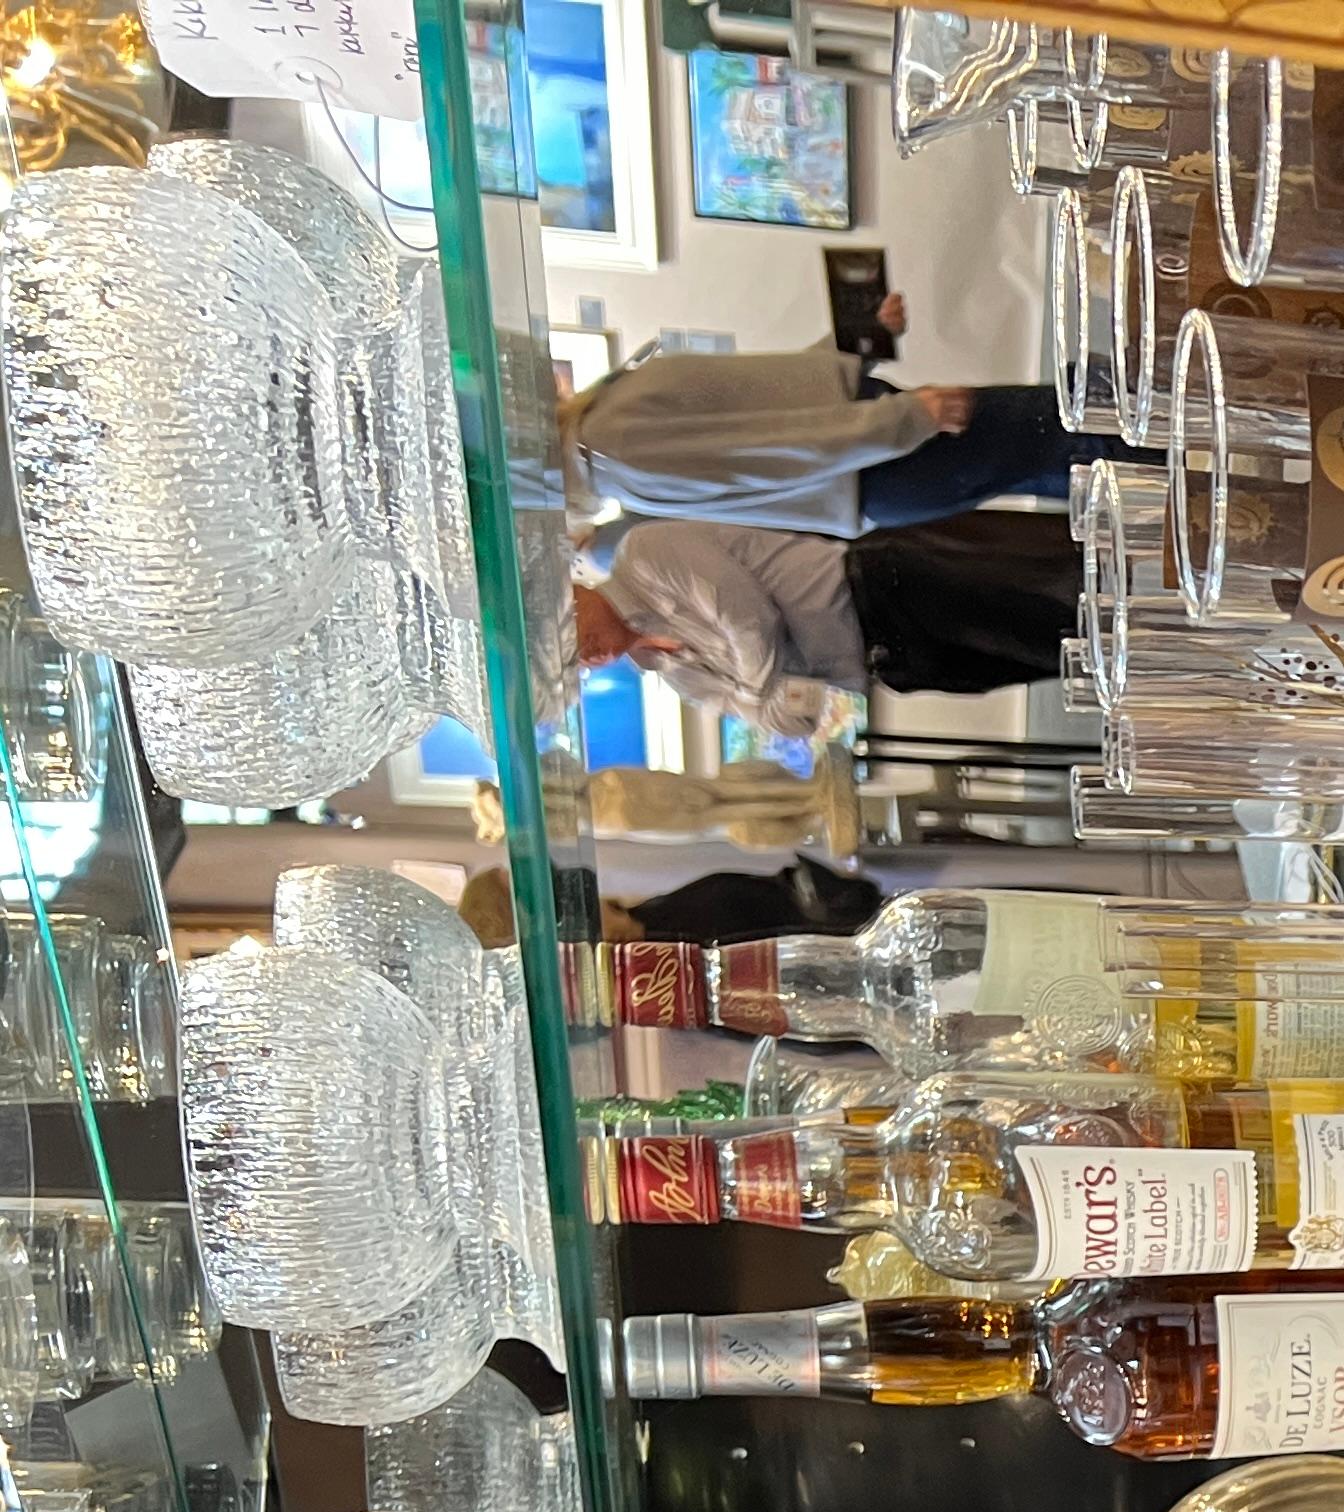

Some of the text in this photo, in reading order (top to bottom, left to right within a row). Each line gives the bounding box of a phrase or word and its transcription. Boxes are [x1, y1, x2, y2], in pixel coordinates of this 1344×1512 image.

[1140, 1179, 1168, 1238] Label
[1278, 1339, 1313, 1448] DE LUZE
[1313, 1375, 1327, 1429] COGNAC
